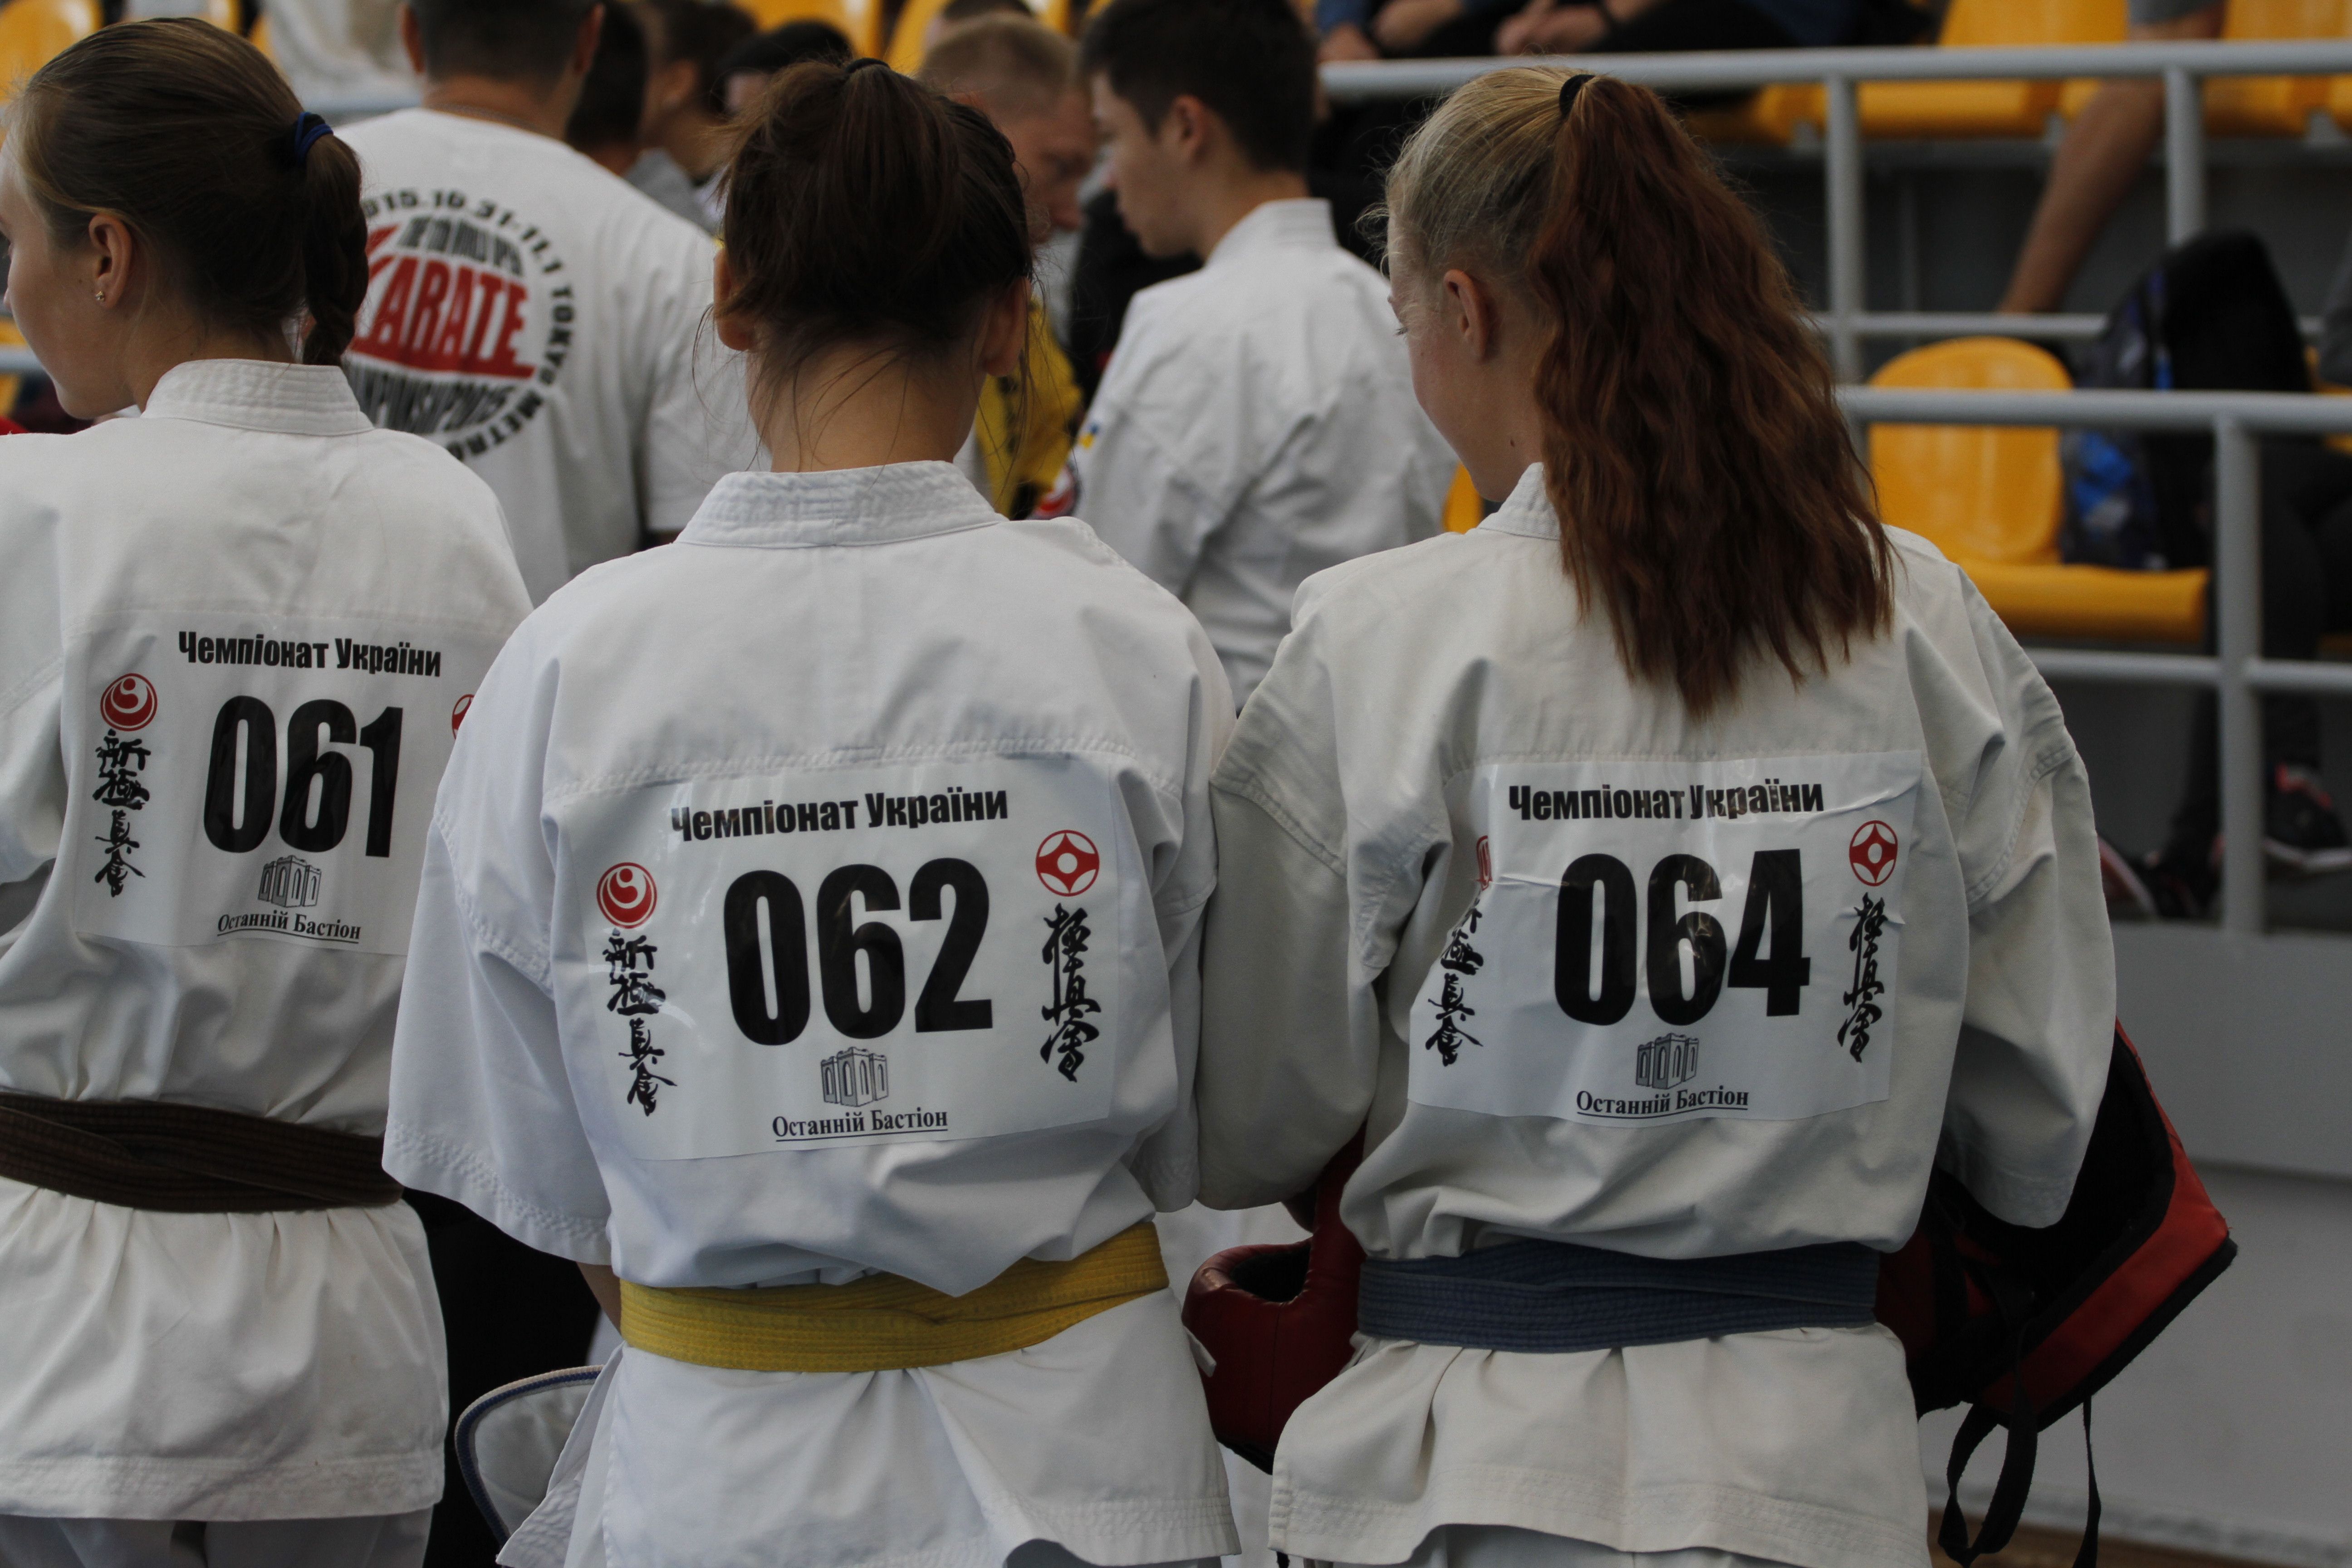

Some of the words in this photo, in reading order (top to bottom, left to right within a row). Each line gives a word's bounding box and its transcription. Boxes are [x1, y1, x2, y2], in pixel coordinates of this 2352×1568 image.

[179, 631, 329, 668] Чемпіонат
[334, 638, 441, 677] України
[203, 696, 403, 858] 061
[1509, 784, 1685, 820] Чемпіонат
[1690, 779, 1824, 819] України
[671, 800, 859, 842] Чемпіонат
[865, 787, 1008, 828] України
[217, 909, 289, 932] Останній
[294, 912, 361, 940] Бастіон
[1554, 848, 1811, 1026] 064
[724, 858, 993, 1046] 062
[772, 1112, 865, 1137] Останній
[870, 1107, 948, 1132] Бастіон
[1576, 1091, 1670, 1115] Останній
[1675, 1085, 1749, 1111] Бастіон
